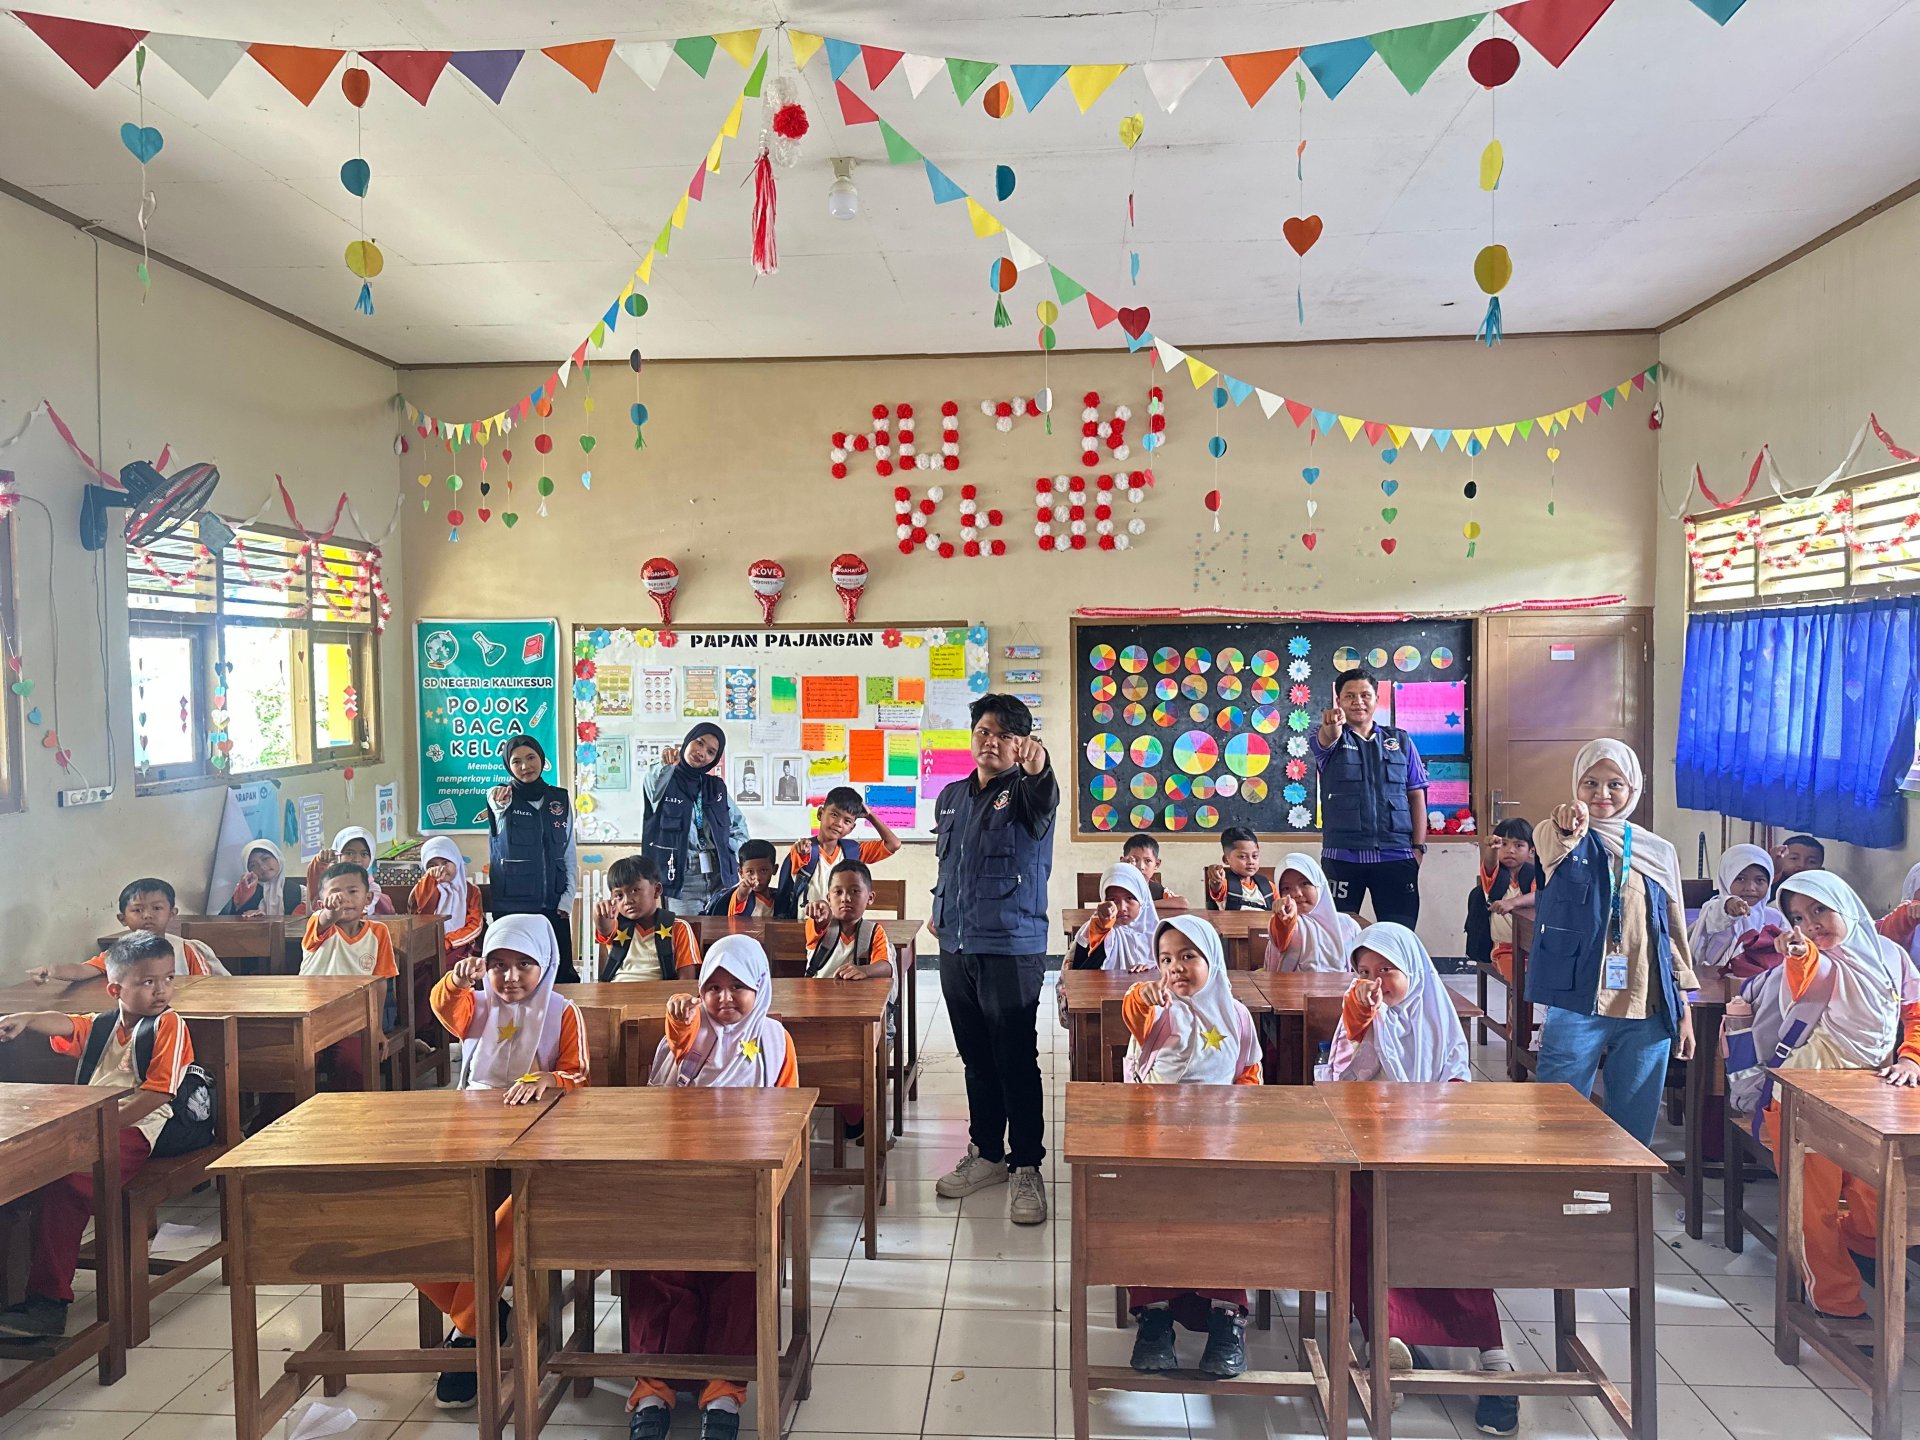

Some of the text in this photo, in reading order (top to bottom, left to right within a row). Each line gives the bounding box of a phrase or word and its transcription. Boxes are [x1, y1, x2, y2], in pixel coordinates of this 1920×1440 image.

[756, 568, 778, 576] LOVE
[690, 633, 873, 648] PAPAN PAJANGAN
[424, 678, 438, 688] SD
[440, 678, 480, 688] NEGERI
[492, 677, 553, 688] KALIKESUR
[447, 697, 528, 714] POJOK
[454, 718, 523, 735] BACA
[451, 740, 505, 756] KELA
[467, 762, 505, 770] Membac
[436, 775, 490, 784] memperkaya
